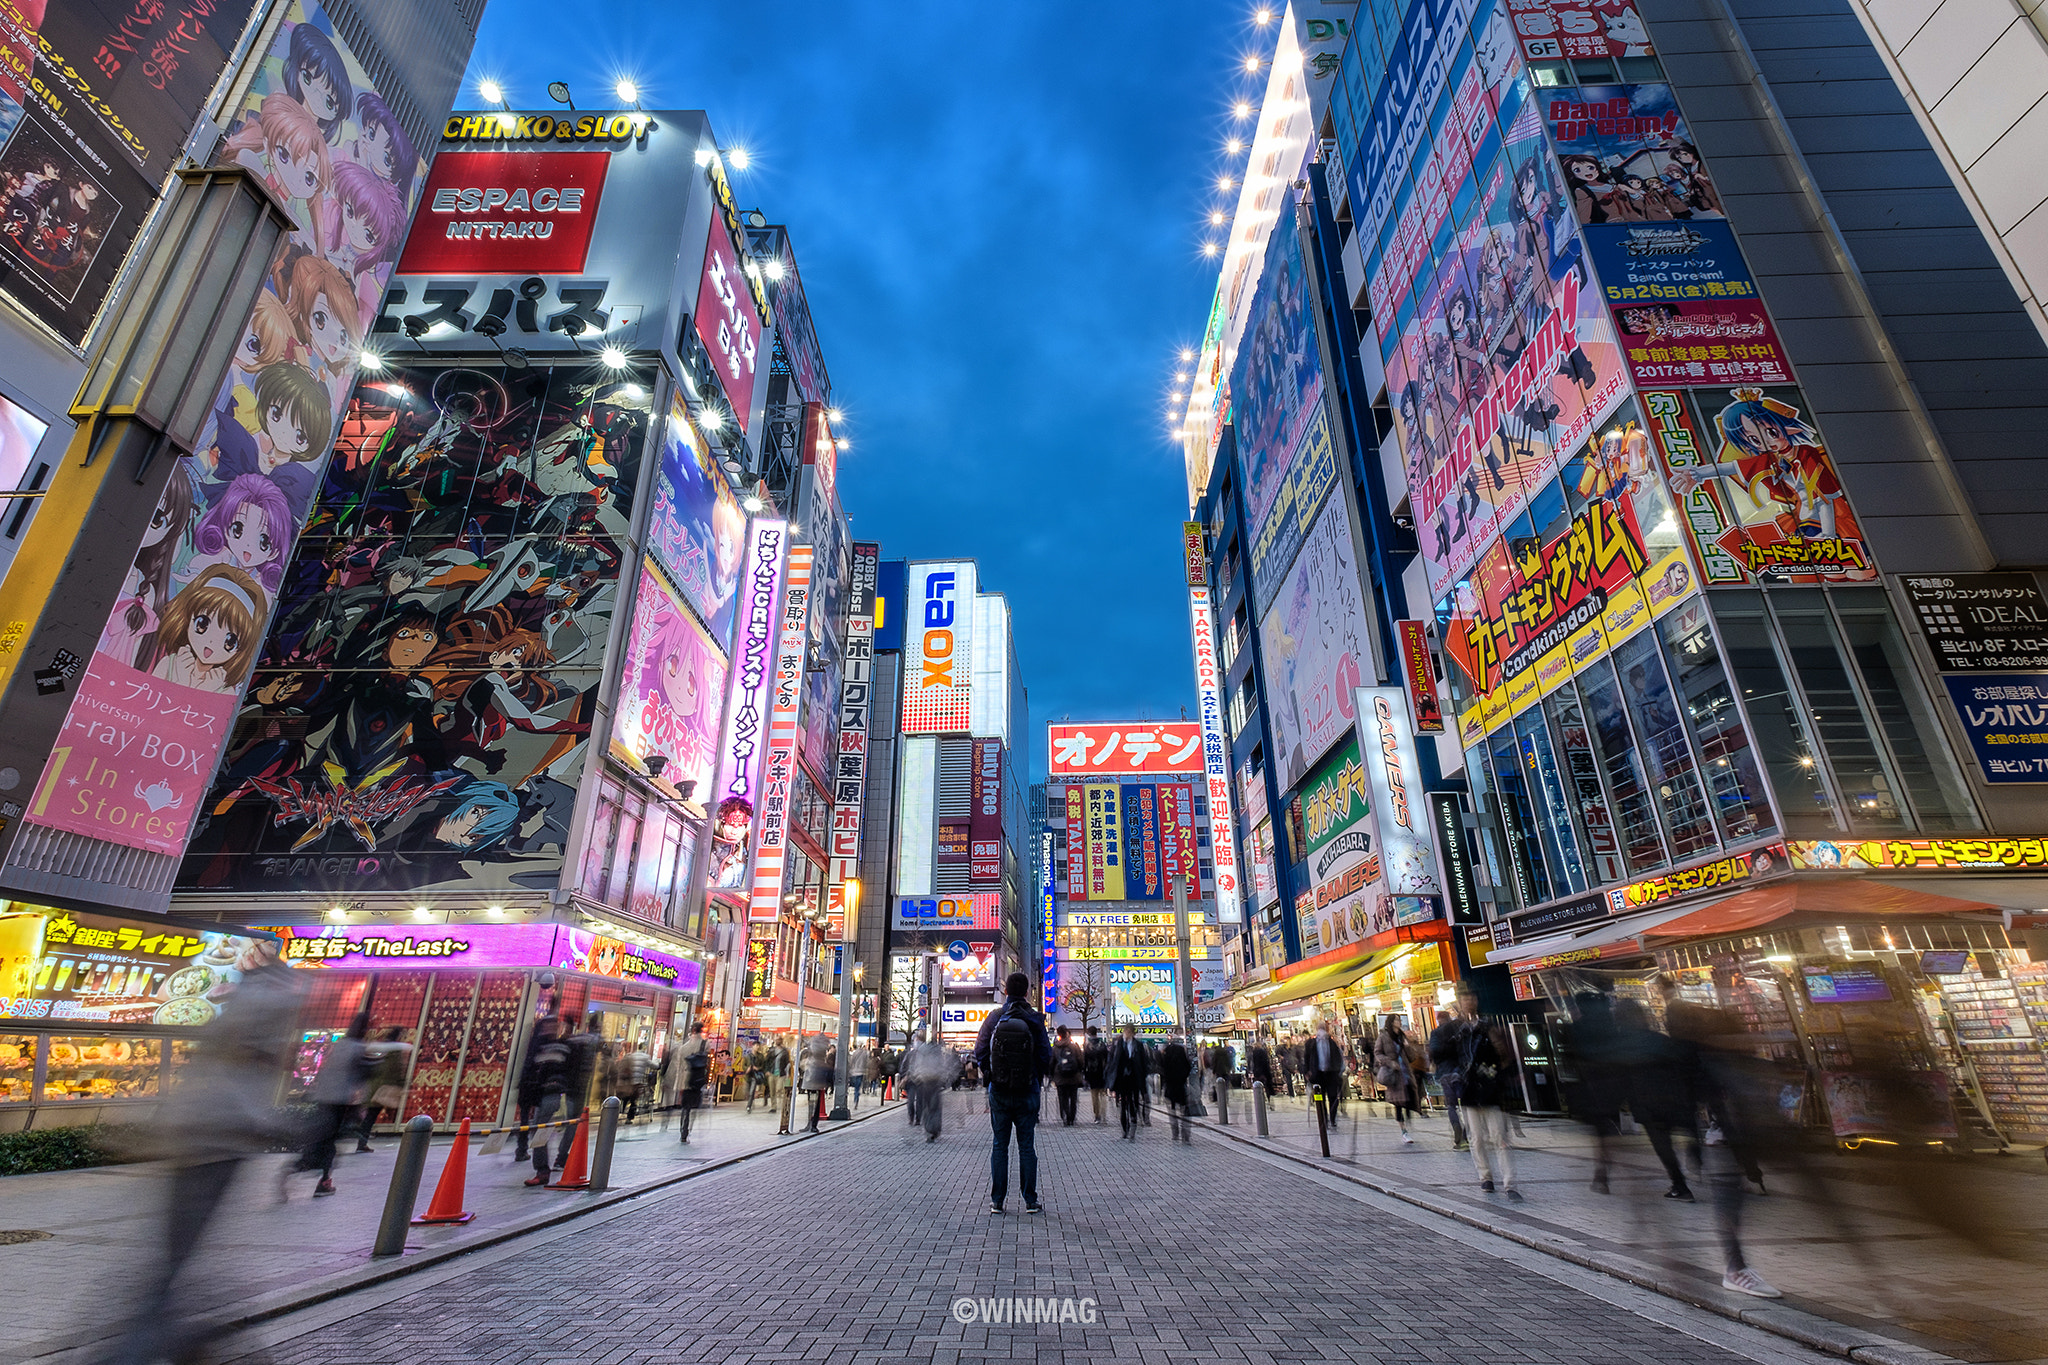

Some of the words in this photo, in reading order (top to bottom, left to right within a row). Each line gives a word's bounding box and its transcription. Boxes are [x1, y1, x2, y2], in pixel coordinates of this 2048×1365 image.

[1528, 42, 1557, 55] 6F
[1563, 35, 1605, 47] 秋葉原
[1566, 46, 1609, 56] 2号店
[1471, 107, 1487, 144] 6F
[431, 187, 585, 213] ESPACE
[446, 221, 554, 240] NITTAKU
[1625, 259, 1716, 271] ブースターパック
[1628, 271, 1668, 283] BanG
[1673, 270, 1725, 282] Dream!
[864, 546, 877, 592] HOBBY
[1186, 533, 1204, 583] まんが喫茶
[1740, 537, 1866, 571] カードキングダム
[850, 546, 864, 613] PARADISE
[1907, 578, 1955, 589] 不動産の
[1912, 588, 2037, 600] トータルコンサルタント
[785, 589, 806, 632] 買取り
[1468, 499, 1647, 693] カードキングダム
[1969, 606, 2048, 624] iDEAL
[1940, 640, 1982, 653] 当ビル
[1984, 639, 2005, 652] 8F
[1194, 609, 1215, 687] TAKARADA
[1205, 733, 1224, 775] 免税商店
[1303, 683, 1333, 743] 3.22
[141, 734, 206, 775] BOX
[974, 743, 983, 775] Flagship
[981, 743, 1000, 778] Duty
[1053, 726, 1201, 767] オノデン
[85, 757, 119, 789] In
[1374, 694, 1415, 834] GAMERS
[1988, 759, 2032, 774] 当ビル
[763, 750, 790, 846] アキバ駅前店
[974, 776, 983, 799] Store
[982, 780, 1000, 816] Free
[71, 789, 177, 839] Stores
[1067, 789, 1082, 819] 免税
[1443, 801, 1454, 829] AKIBA
[1068, 820, 1084, 852] TAX
[1103, 788, 1119, 867] 冷蔵庫洗濯機
[1127, 796, 1143, 880] お見積り無料です
[1043, 832, 1053, 888] Panasonic
[1448, 829, 1461, 859] STORE
[1889, 840, 2048, 865] カードキングダ
[973, 865, 998, 874] 면세점
[1070, 853, 1085, 894] FREE
[1316, 854, 1382, 911] GAMERS
[1456, 857, 1471, 914] ALIENWARE
[1642, 858, 1750, 902] カードキングダム
[900, 919, 918, 927] Home
[1044, 894, 1053, 942] ONODEN
[1075, 915, 1097, 924] TAX
[1100, 915, 1130, 924] FREE
[1132, 914, 1159, 924] 免税店
[1520, 914, 1553, 929] ALIENWARE
[1554, 908, 1575, 920] STORE
[1576, 902, 1598, 914] AKIBA
[72, 926, 207, 958] 銀座ライオン
[1075, 949, 1099, 959] テレビ
[1131, 949, 1164, 959] エアコン
[461, 1067, 504, 1088] AKB48
